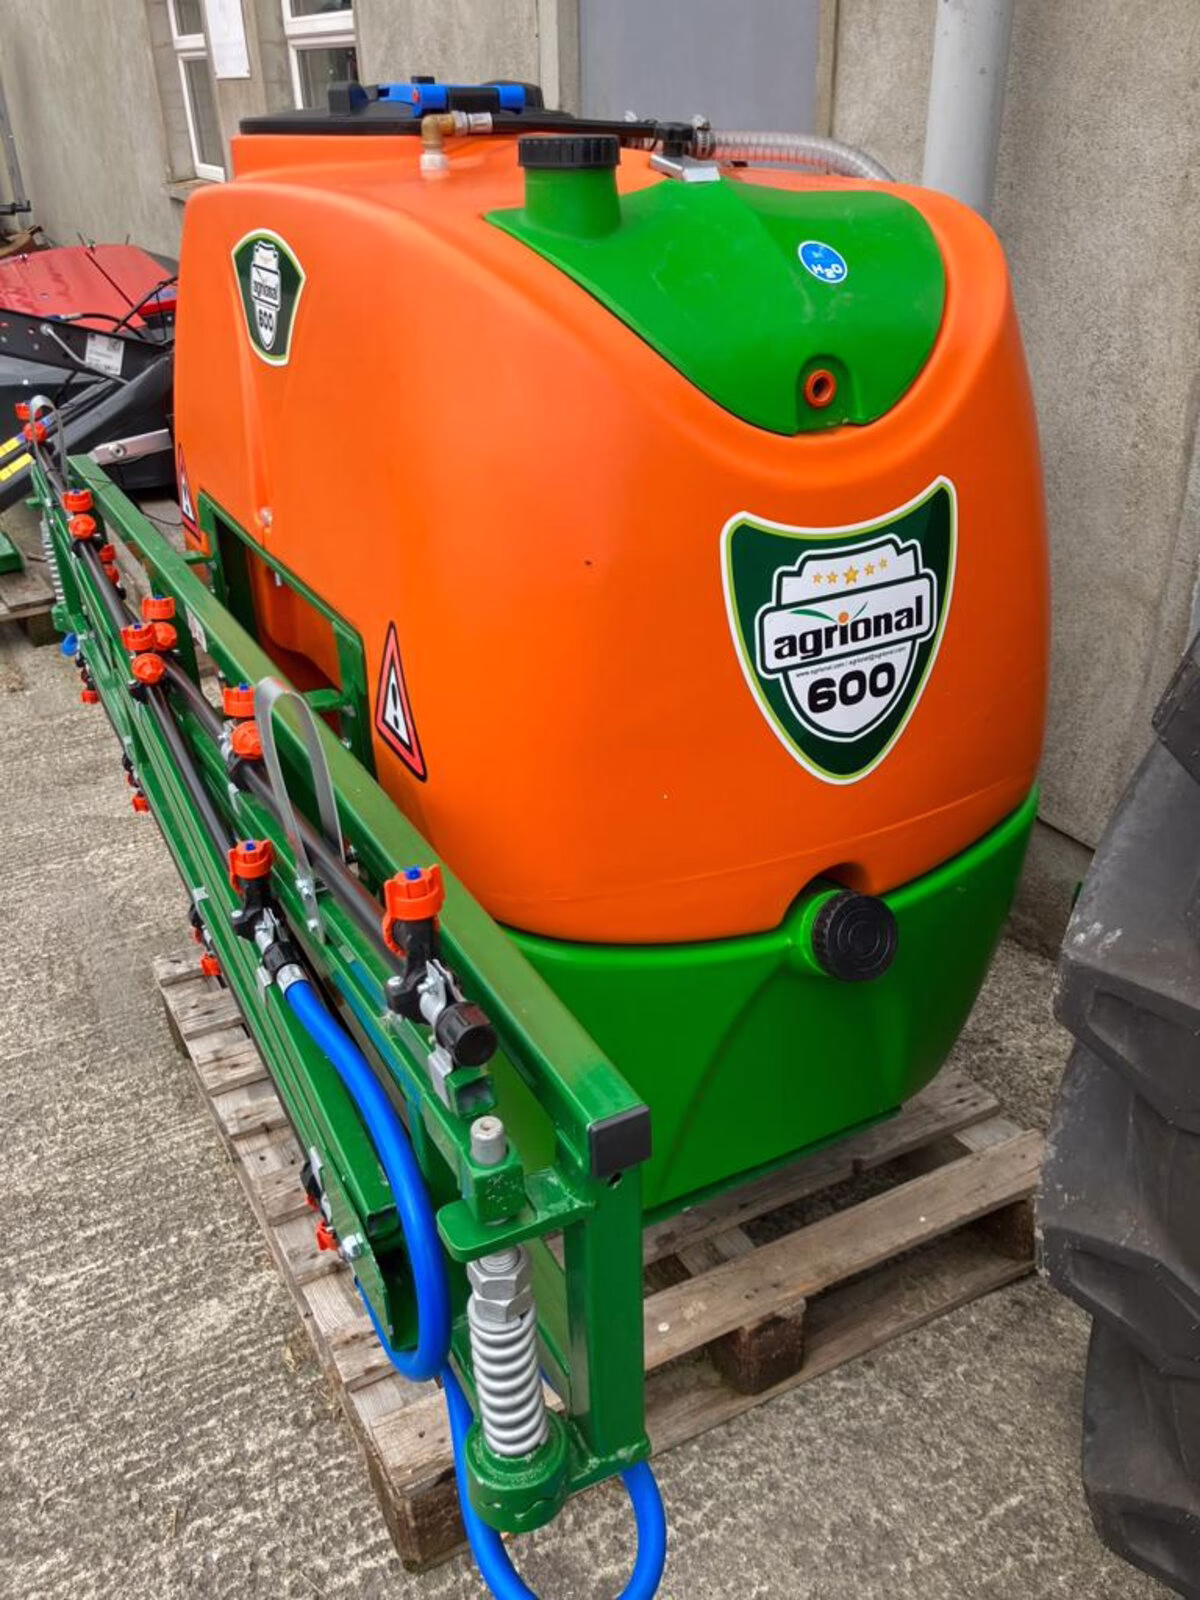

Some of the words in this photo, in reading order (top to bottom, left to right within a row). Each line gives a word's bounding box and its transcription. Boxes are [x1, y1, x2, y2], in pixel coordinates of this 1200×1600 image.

[259, 308, 273, 331] 600
[773, 595, 923, 661] agrional
[807, 662, 896, 714] 600
